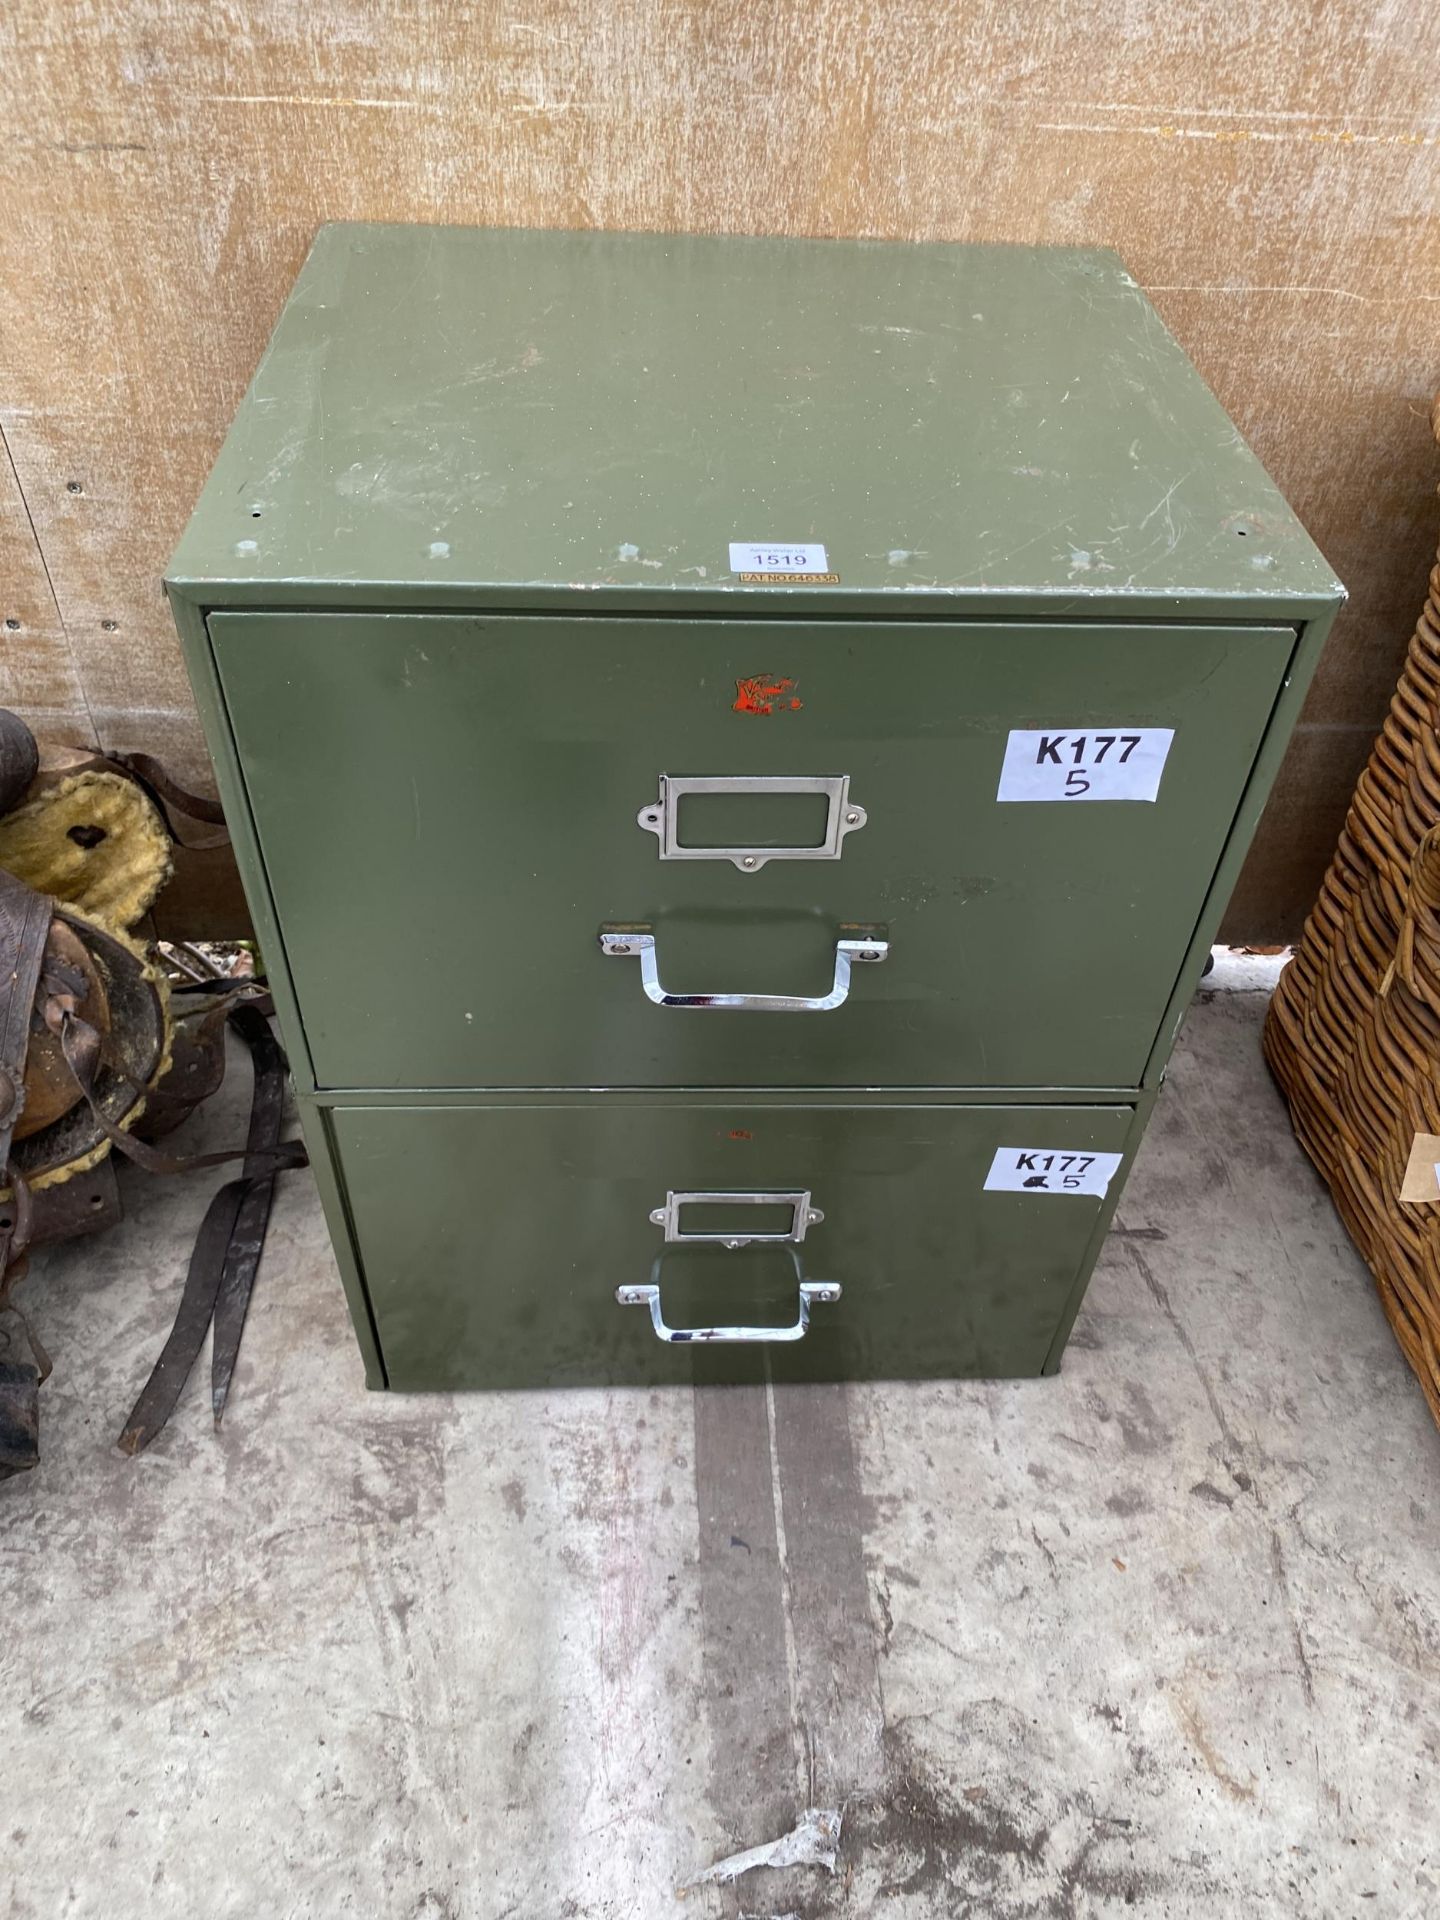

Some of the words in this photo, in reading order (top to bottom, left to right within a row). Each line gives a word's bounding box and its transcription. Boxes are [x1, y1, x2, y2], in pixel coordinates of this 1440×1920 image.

[753, 554, 807, 566] 1519
[1036, 736, 1142, 765] K177
[1064, 769, 1090, 797] 5
[1015, 1153, 1096, 1173] K177
[1063, 1175, 1086, 1188] 5
